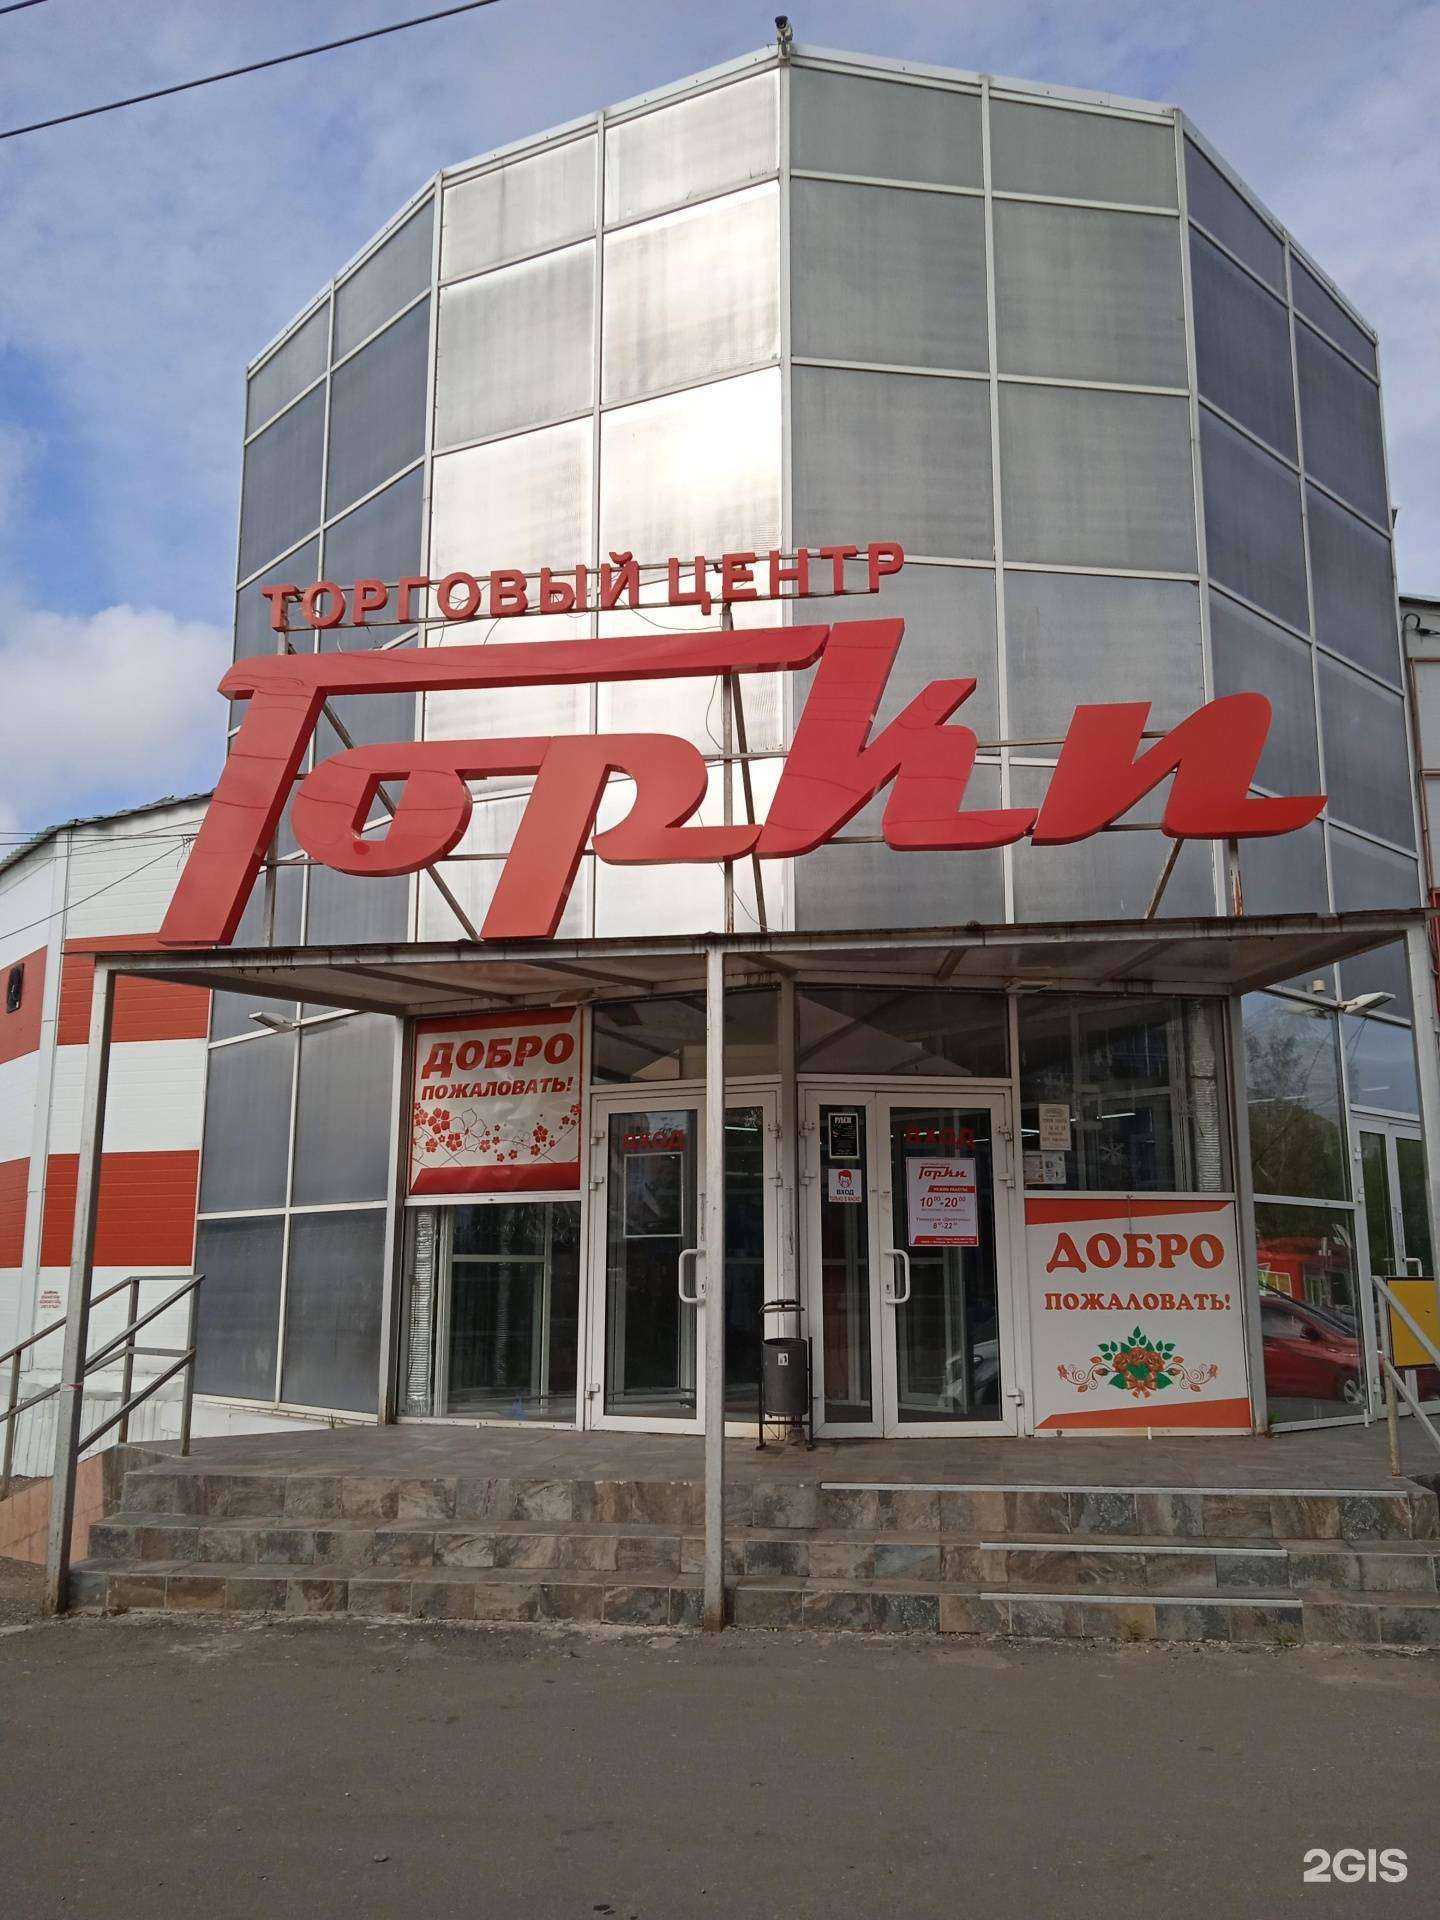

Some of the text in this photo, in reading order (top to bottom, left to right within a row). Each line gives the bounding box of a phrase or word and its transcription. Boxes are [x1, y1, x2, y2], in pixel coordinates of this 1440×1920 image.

[262, 542, 905, 632] ТОРГОВЫЙ ЦЕНТР
[159, 618, 1328, 947] Горки
[421, 1032, 575, 1080] ДОБРО
[421, 1076, 573, 1101] ПОЖАЛОВАТЬ!
[1046, 1232, 1225, 1274] ДОБРО
[1044, 1292, 1231, 1312] ПОЖАЛОВАТЬ!
